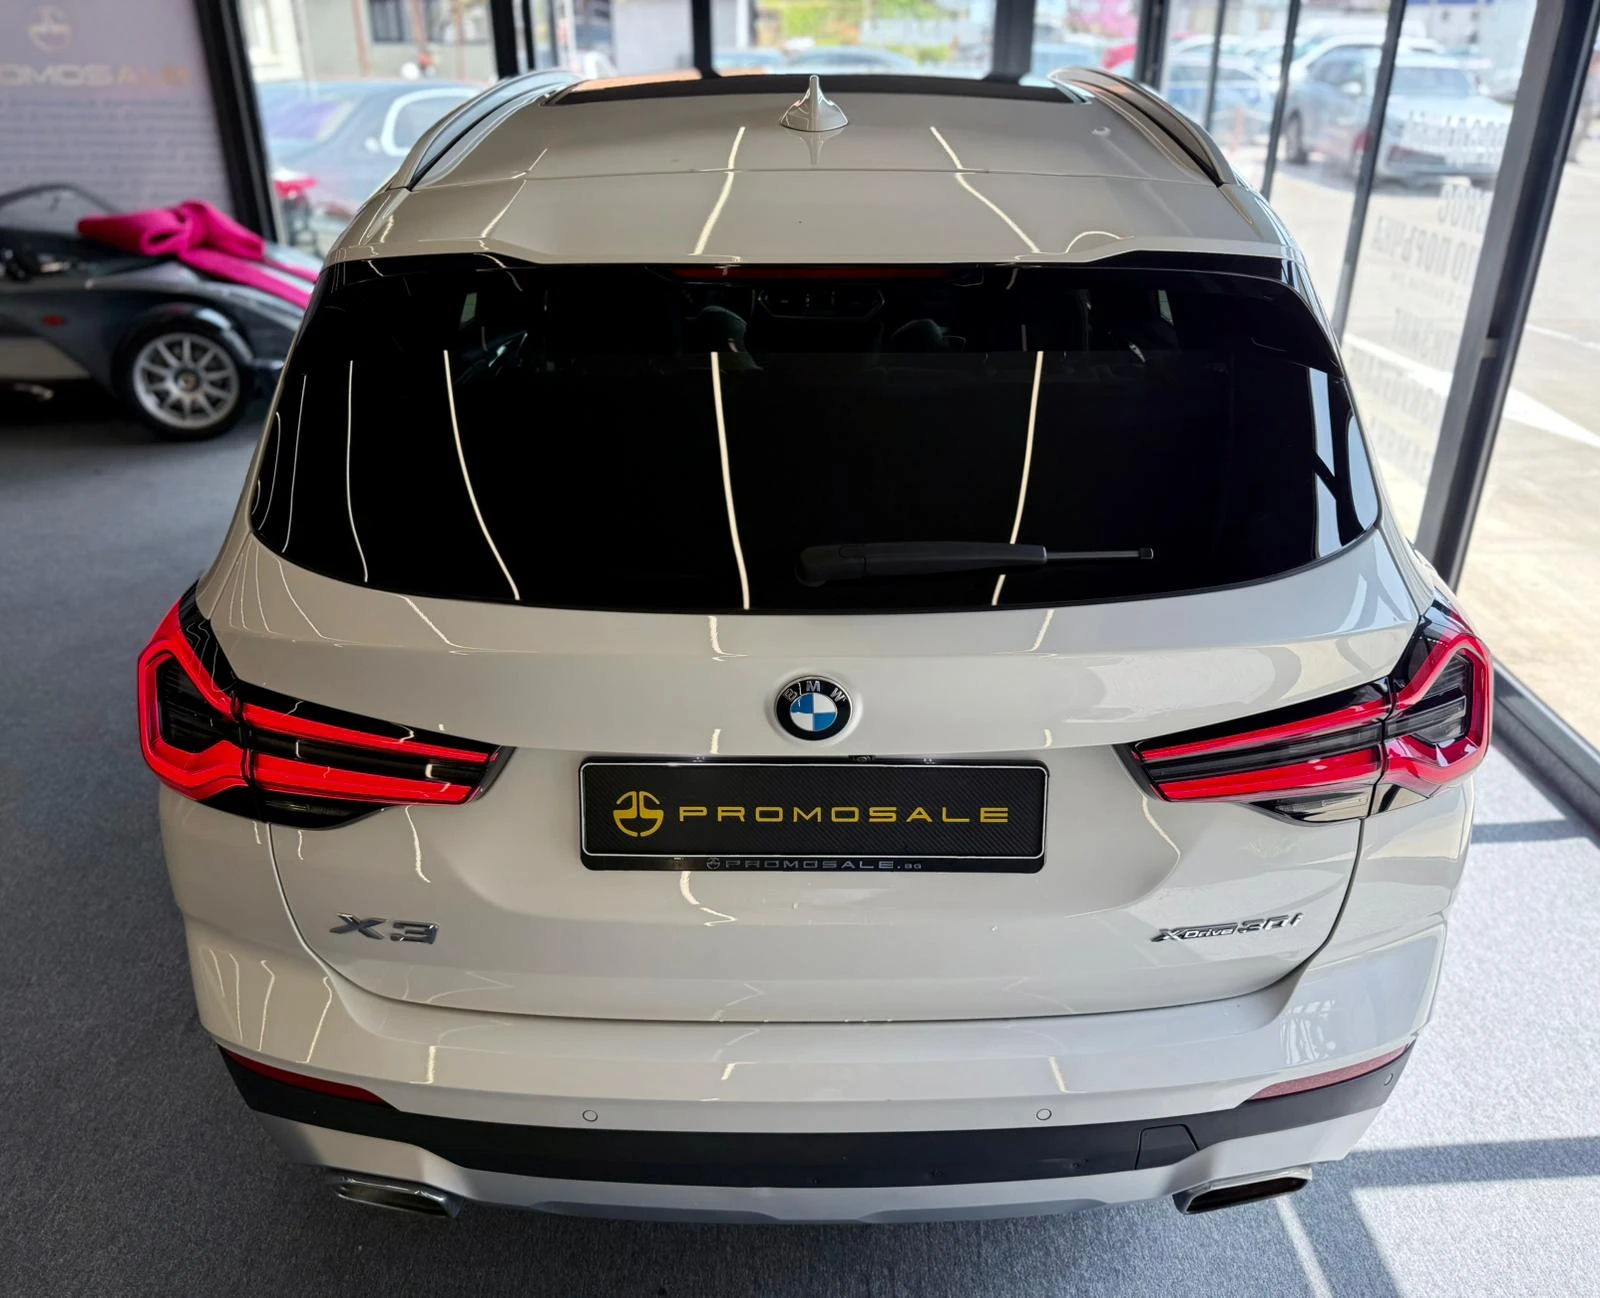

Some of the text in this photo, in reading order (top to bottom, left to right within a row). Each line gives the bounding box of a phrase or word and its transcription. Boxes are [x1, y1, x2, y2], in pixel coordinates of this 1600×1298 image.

[783, 680, 847, 704] BMW
[679, 806, 1009, 823] PROMOSALE
[329, 911, 439, 945] X3
